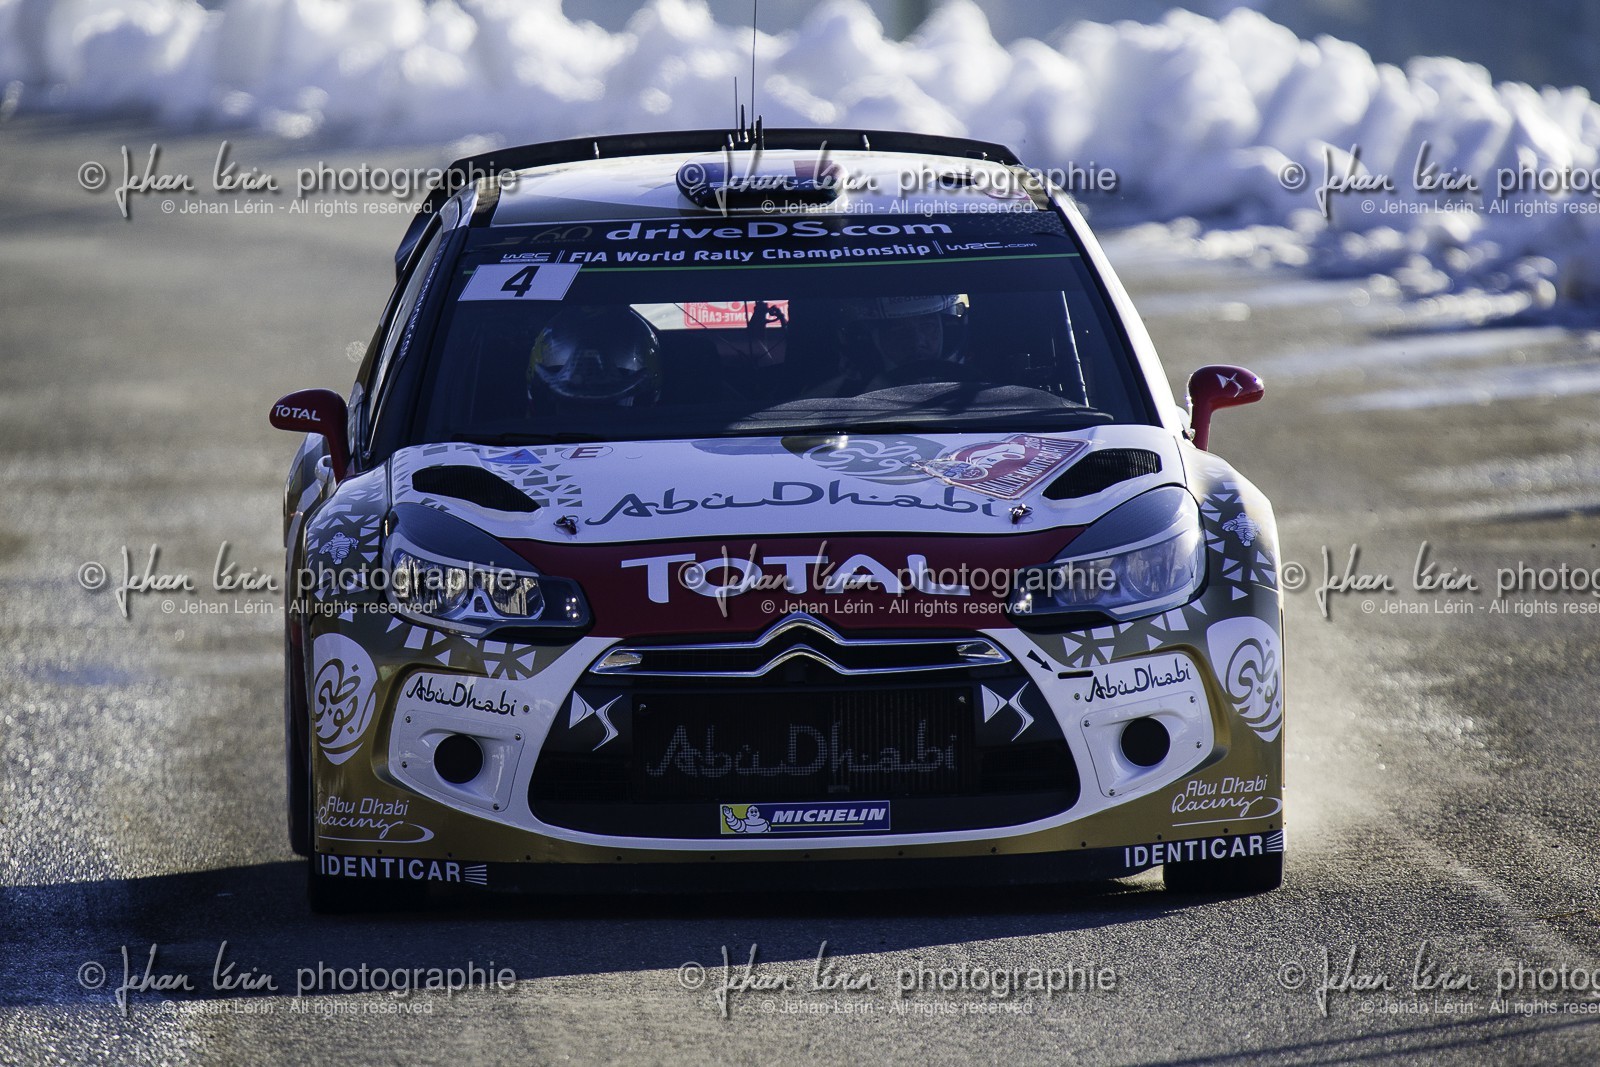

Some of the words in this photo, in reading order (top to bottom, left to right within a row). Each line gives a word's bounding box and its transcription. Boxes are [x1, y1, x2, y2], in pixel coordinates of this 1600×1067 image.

[606, 221, 952, 241] driveDS.com
[569, 252, 607, 262] FIA
[617, 251, 685, 262] World
[694, 249, 754, 262] Rally
[762, 244, 931, 261] Championship
[500, 266, 541, 298] 4
[275, 405, 321, 421] TOTAL
[570, 447, 604, 458] E
[970, 473, 1032, 496] RALLYE
[621, 553, 970, 603] TOTAL
[1186, 780, 1217, 798] Abu
[1221, 775, 1268, 795] Dhabi
[327, 796, 355, 814] Abu
[360, 798, 409, 816] Dhabi
[772, 807, 886, 824] MICHELIN
[1171, 794, 1264, 817] Racing
[316, 806, 404, 839] Racing
[1125, 836, 1263, 868] IDENTICAR
[321, 854, 461, 882] IDENTICAR
